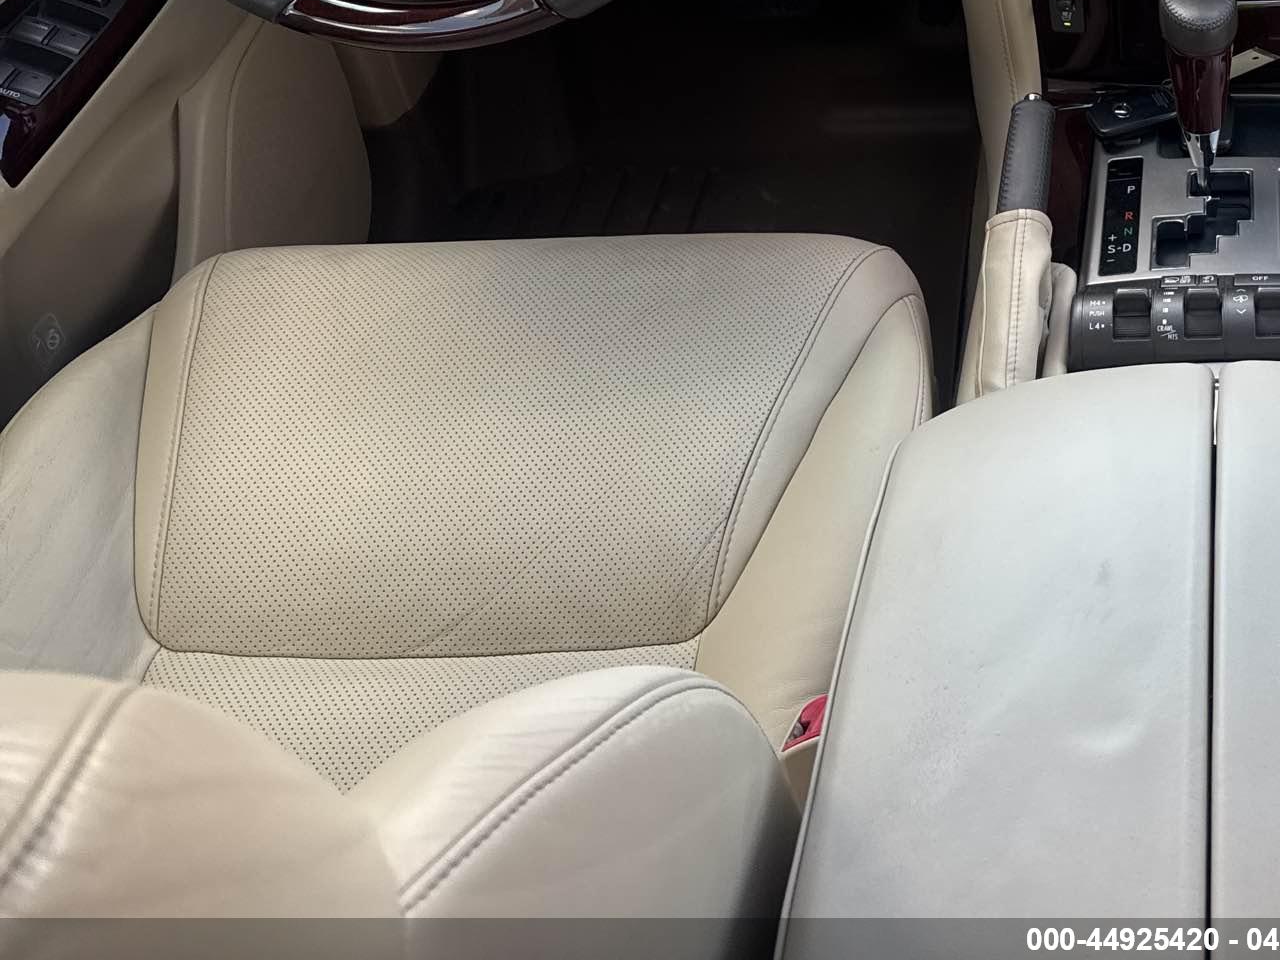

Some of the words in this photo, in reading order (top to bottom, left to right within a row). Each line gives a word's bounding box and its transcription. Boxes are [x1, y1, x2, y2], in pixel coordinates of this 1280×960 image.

[1127, 185, 1136, 194] P
[1124, 211, 1133, 220] R
[1123, 226, 1133, 236] N
